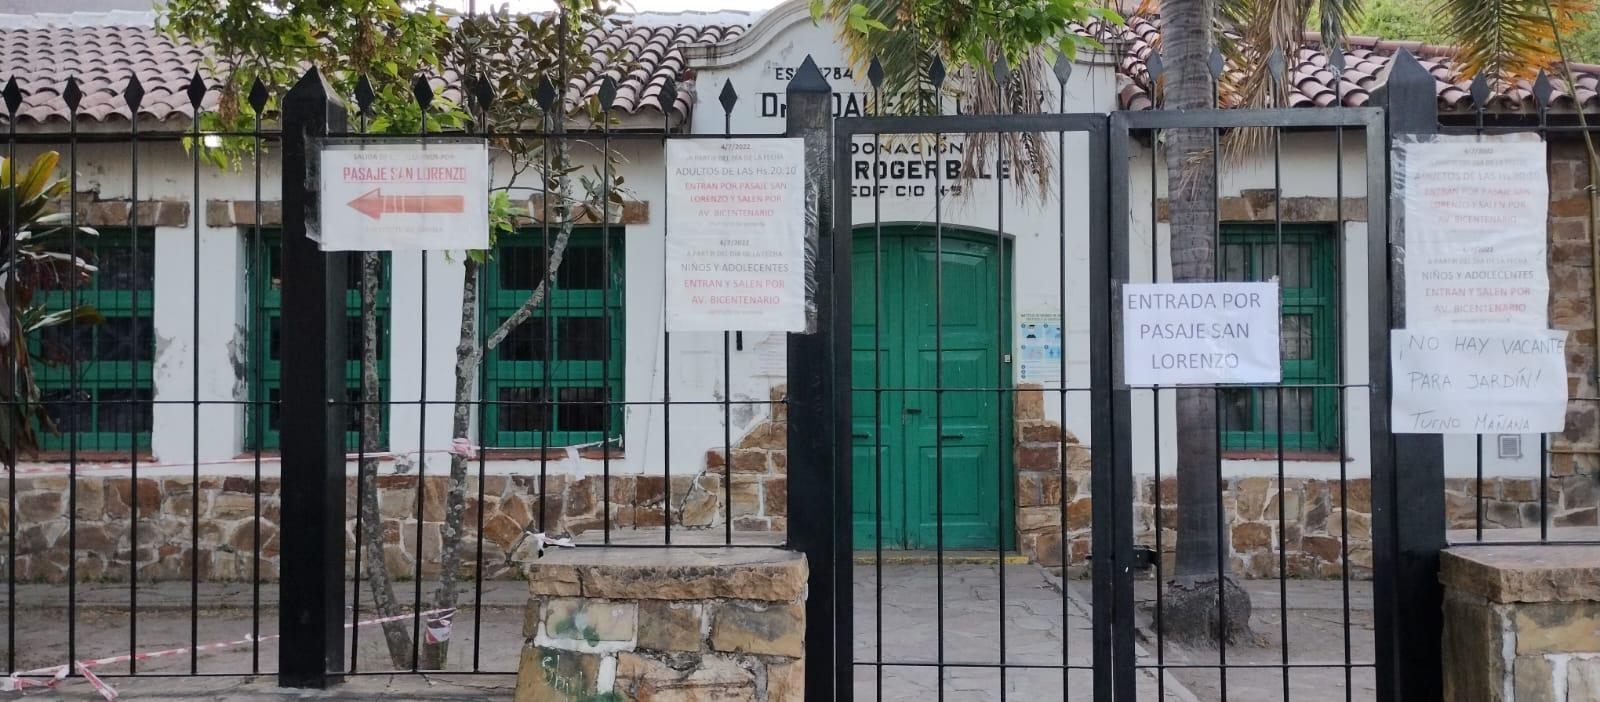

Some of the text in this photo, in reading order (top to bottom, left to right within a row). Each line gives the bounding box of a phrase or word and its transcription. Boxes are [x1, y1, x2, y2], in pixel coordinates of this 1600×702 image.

[343, 166, 387, 180] PASAJE
[391, 166, 413, 180] SAN
[676, 166, 719, 176] ADULTOS
[722, 166, 734, 176] DE
[737, 166, 753, 176] LAS
[855, 160, 937, 180] ROGER
[685, 182, 787, 190] ENTRAN POR PASAJE SAN
[714, 209, 774, 217] BICENTENARIO
[680, 262, 790, 272] NIÑOS Y ADOLECENTES
[1422, 270, 1534, 280] NIÑOS Y ADOLECENTES
[684, 280, 784, 288] ENTRAN Y SALEN POR
[1426, 288, 1531, 296] ENTRAN Y SALEN POR
[692, 296, 780, 304] AV. BICENTENARIO
[1128, 293, 1262, 310] ENTRADA POR
[1454, 304, 1526, 313] BICENTENARIO
[1140, 323, 1249, 340] PASAJE SAN
[1455, 335, 1490, 355] HAY
[1152, 353, 1238, 370] LORENZO
[1408, 371, 1451, 392] PARA
